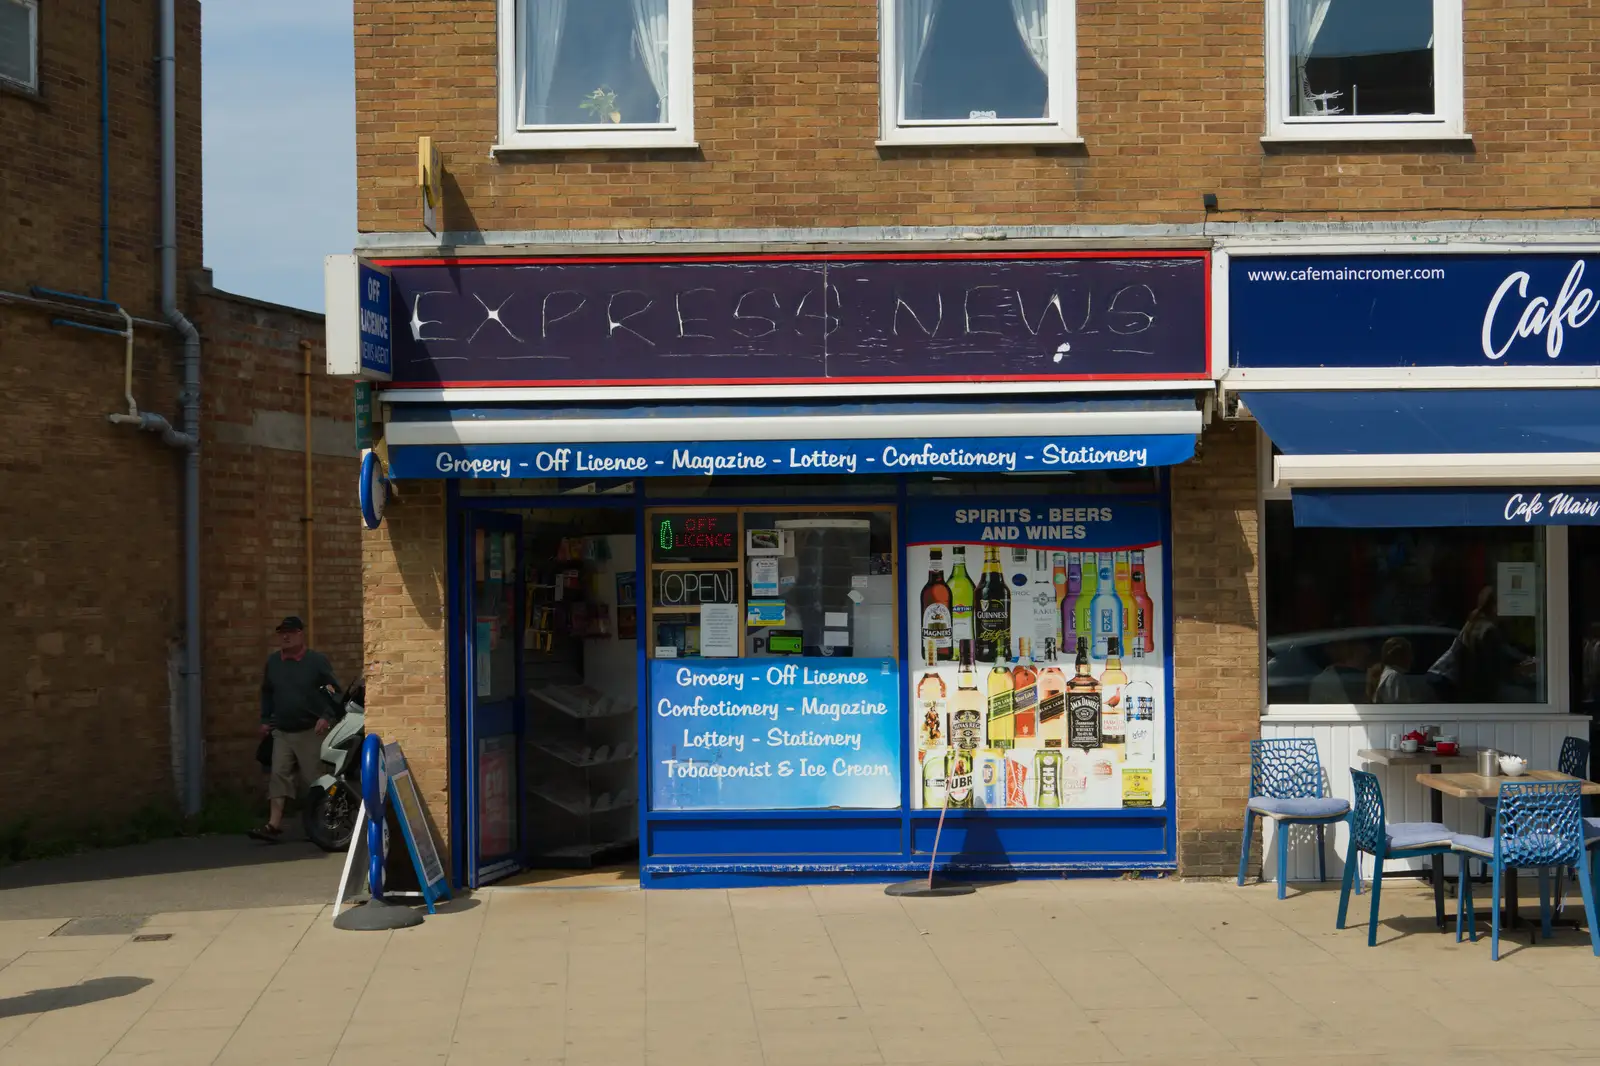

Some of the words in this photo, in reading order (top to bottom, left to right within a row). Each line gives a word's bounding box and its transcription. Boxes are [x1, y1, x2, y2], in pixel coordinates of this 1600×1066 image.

[1248, 267, 1445, 281] www.cafemaincromer.com
[367, 277, 380, 303] OFF
[410, 284, 841, 346] EXPRESS
[893, 284, 1156, 338] NEWS
[1482, 259, 1600, 359] Cafe
[361, 307, 388, 339] LICENCE
[436, 452, 511, 477] Grocery
[535, 448, 571, 471] Off
[576, 451, 648, 471] Licence
[672, 449, 766, 475] Magazine
[790, 448, 857, 473] Lottery
[882, 443, 1016, 470] Confectionery
[1042, 444, 1147, 467] Stationery
[955, 508, 1031, 524] SPIRITS
[1049, 507, 1113, 522] BEERS
[1504, 493, 1544, 522] Cafe
[1548, 493, 1600, 517] Main
[685, 518, 717, 531] OFF
[981, 526, 1020, 541] AND
[1027, 525, 1086, 540] WINES
[675, 533, 732, 548] LICENCE
[664, 573, 729, 603] OPEN
[977, 611, 1008, 619] GUINNESS
[1103, 611, 1111, 631] WKD
[676, 667, 744, 690] Grocery
[766, 665, 798, 685] Off
[803, 667, 868, 685] Licence
[657, 696, 779, 720] Confectionery
[802, 697, 888, 721] Magazine
[683, 729, 745, 752] Lottery
[767, 727, 861, 750] Stationery
[661, 757, 772, 778] Tobacconist
[777, 761, 793, 777] &
[800, 758, 827, 777] Ice
[832, 757, 891, 777] Cream
